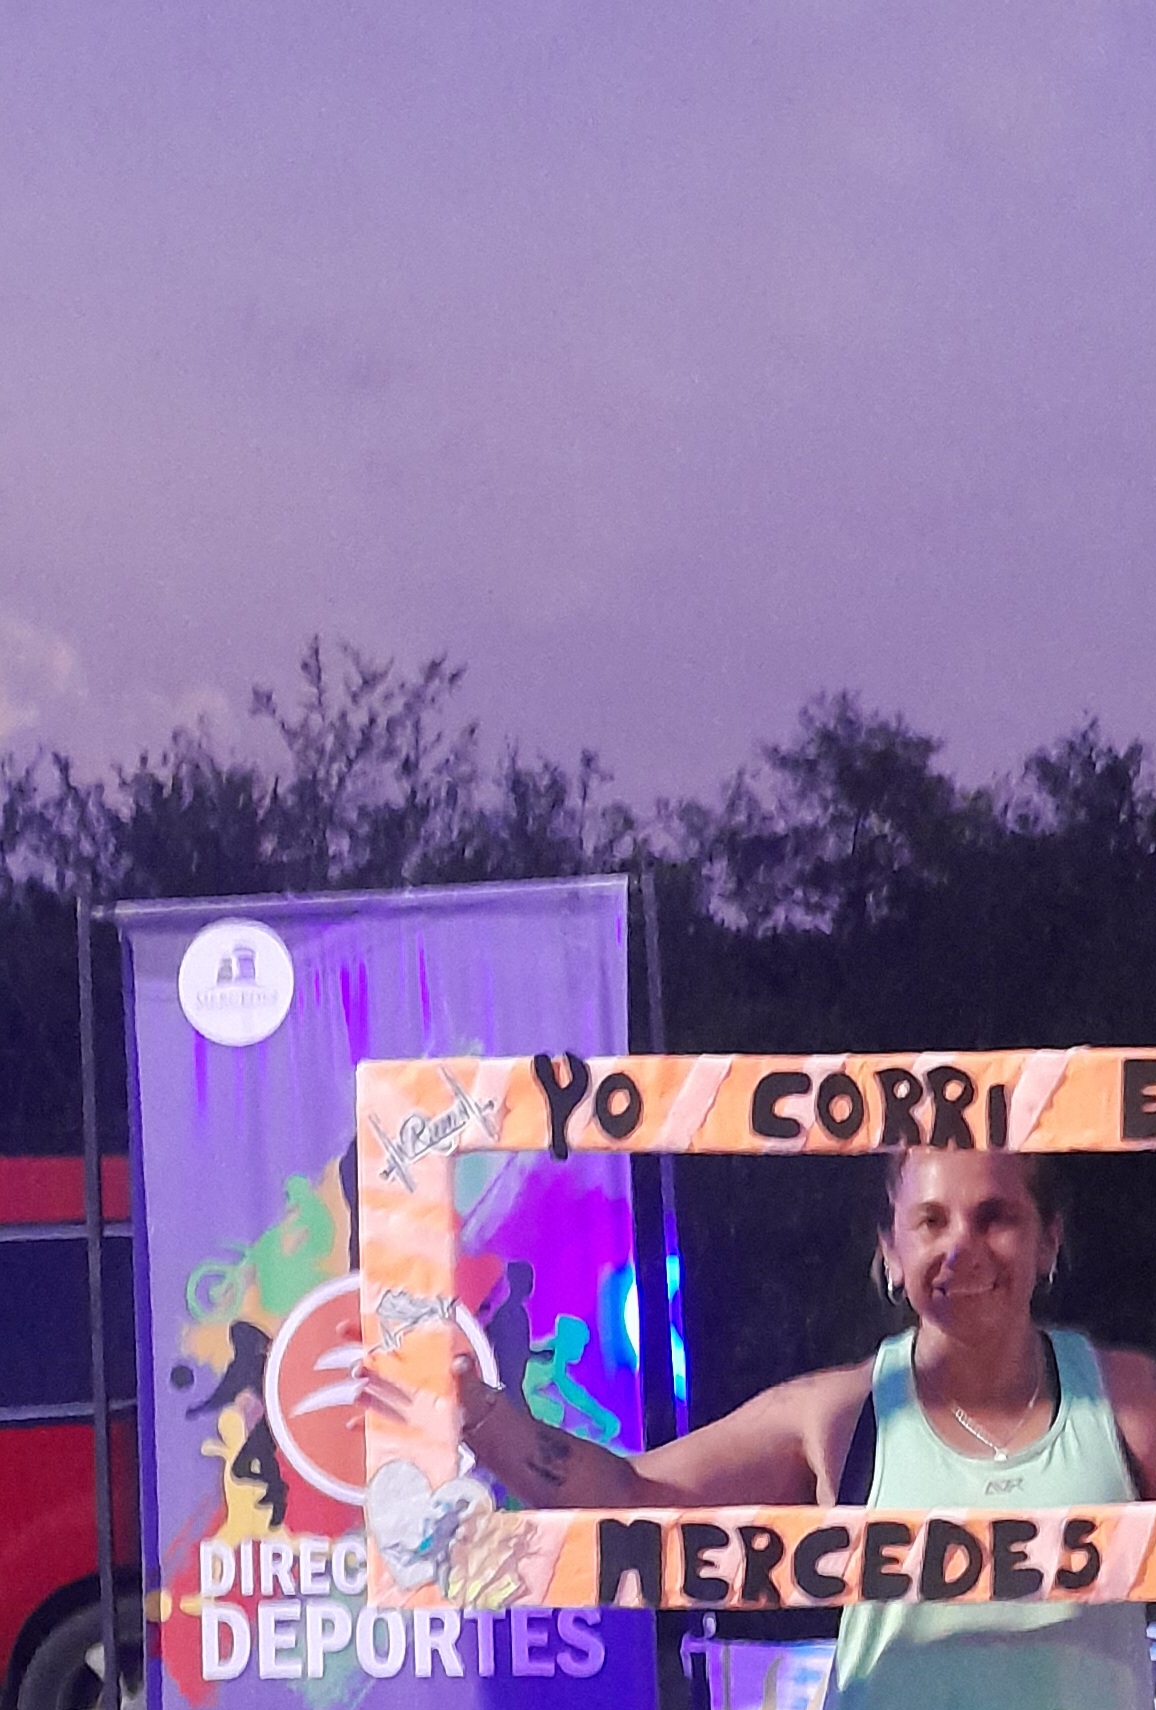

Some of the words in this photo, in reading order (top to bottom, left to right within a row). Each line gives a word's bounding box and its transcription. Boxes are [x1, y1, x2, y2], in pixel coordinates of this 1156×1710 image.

[533, 1050, 642, 1161] YO
[751, 1065, 1008, 1150] CORRI
[599, 1518, 1101, 1606] MERCEDES
[201, 1600, 606, 1681] DEPORTES
